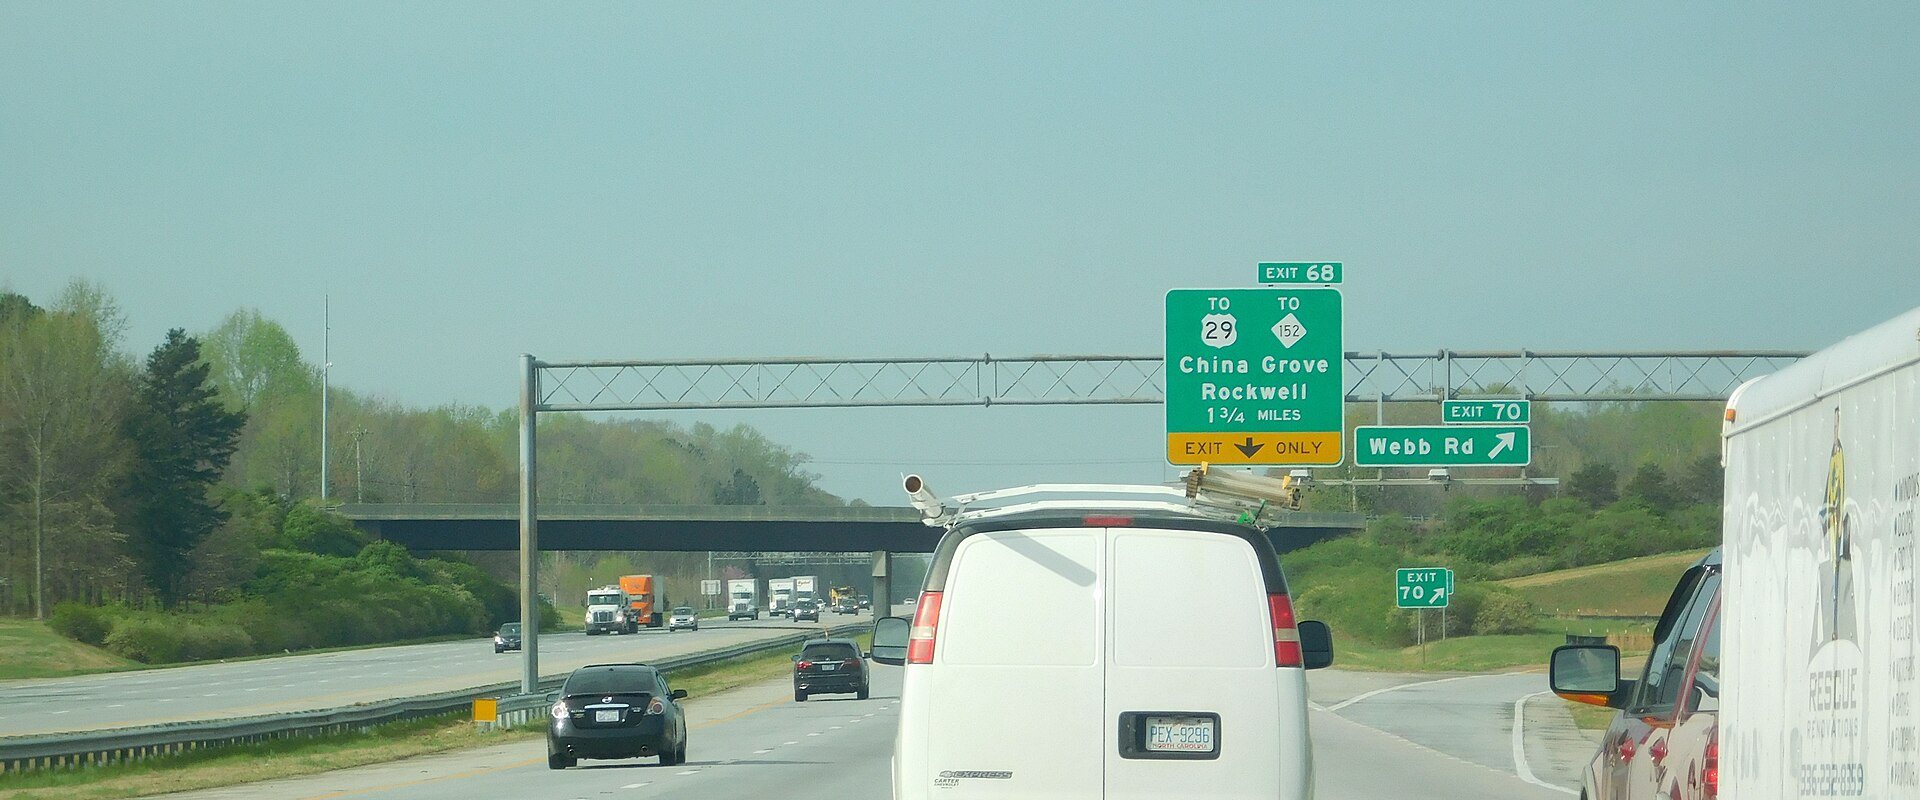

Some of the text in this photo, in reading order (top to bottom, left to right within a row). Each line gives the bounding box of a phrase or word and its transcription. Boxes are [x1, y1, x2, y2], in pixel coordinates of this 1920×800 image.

[1266, 264, 1334, 281] EXIT 68
[1207, 297, 1231, 310] TO
[1277, 297, 1300, 310] TO
[1205, 321, 1233, 340] 29
[1278, 324, 1300, 337] 152
[1179, 355, 1329, 374] China Grove
[1201, 382, 1307, 400] Rockwell
[1257, 409, 1301, 421] MILES
[1451, 403, 1521, 420] EXIT 70
[1185, 441, 1322, 455] EXIT ONLY
[1369, 437, 1474, 455] Webb Rd
[1408, 572, 1436, 582] EXIT
[1400, 586, 1424, 600] 70
[1809, 668, 1857, 711] RESCUE
[1150, 726, 1210, 743] PEX-9296
[1807, 718, 1858, 739] RENOVATIONS
[953, 771, 1013, 779] EXPRESS
